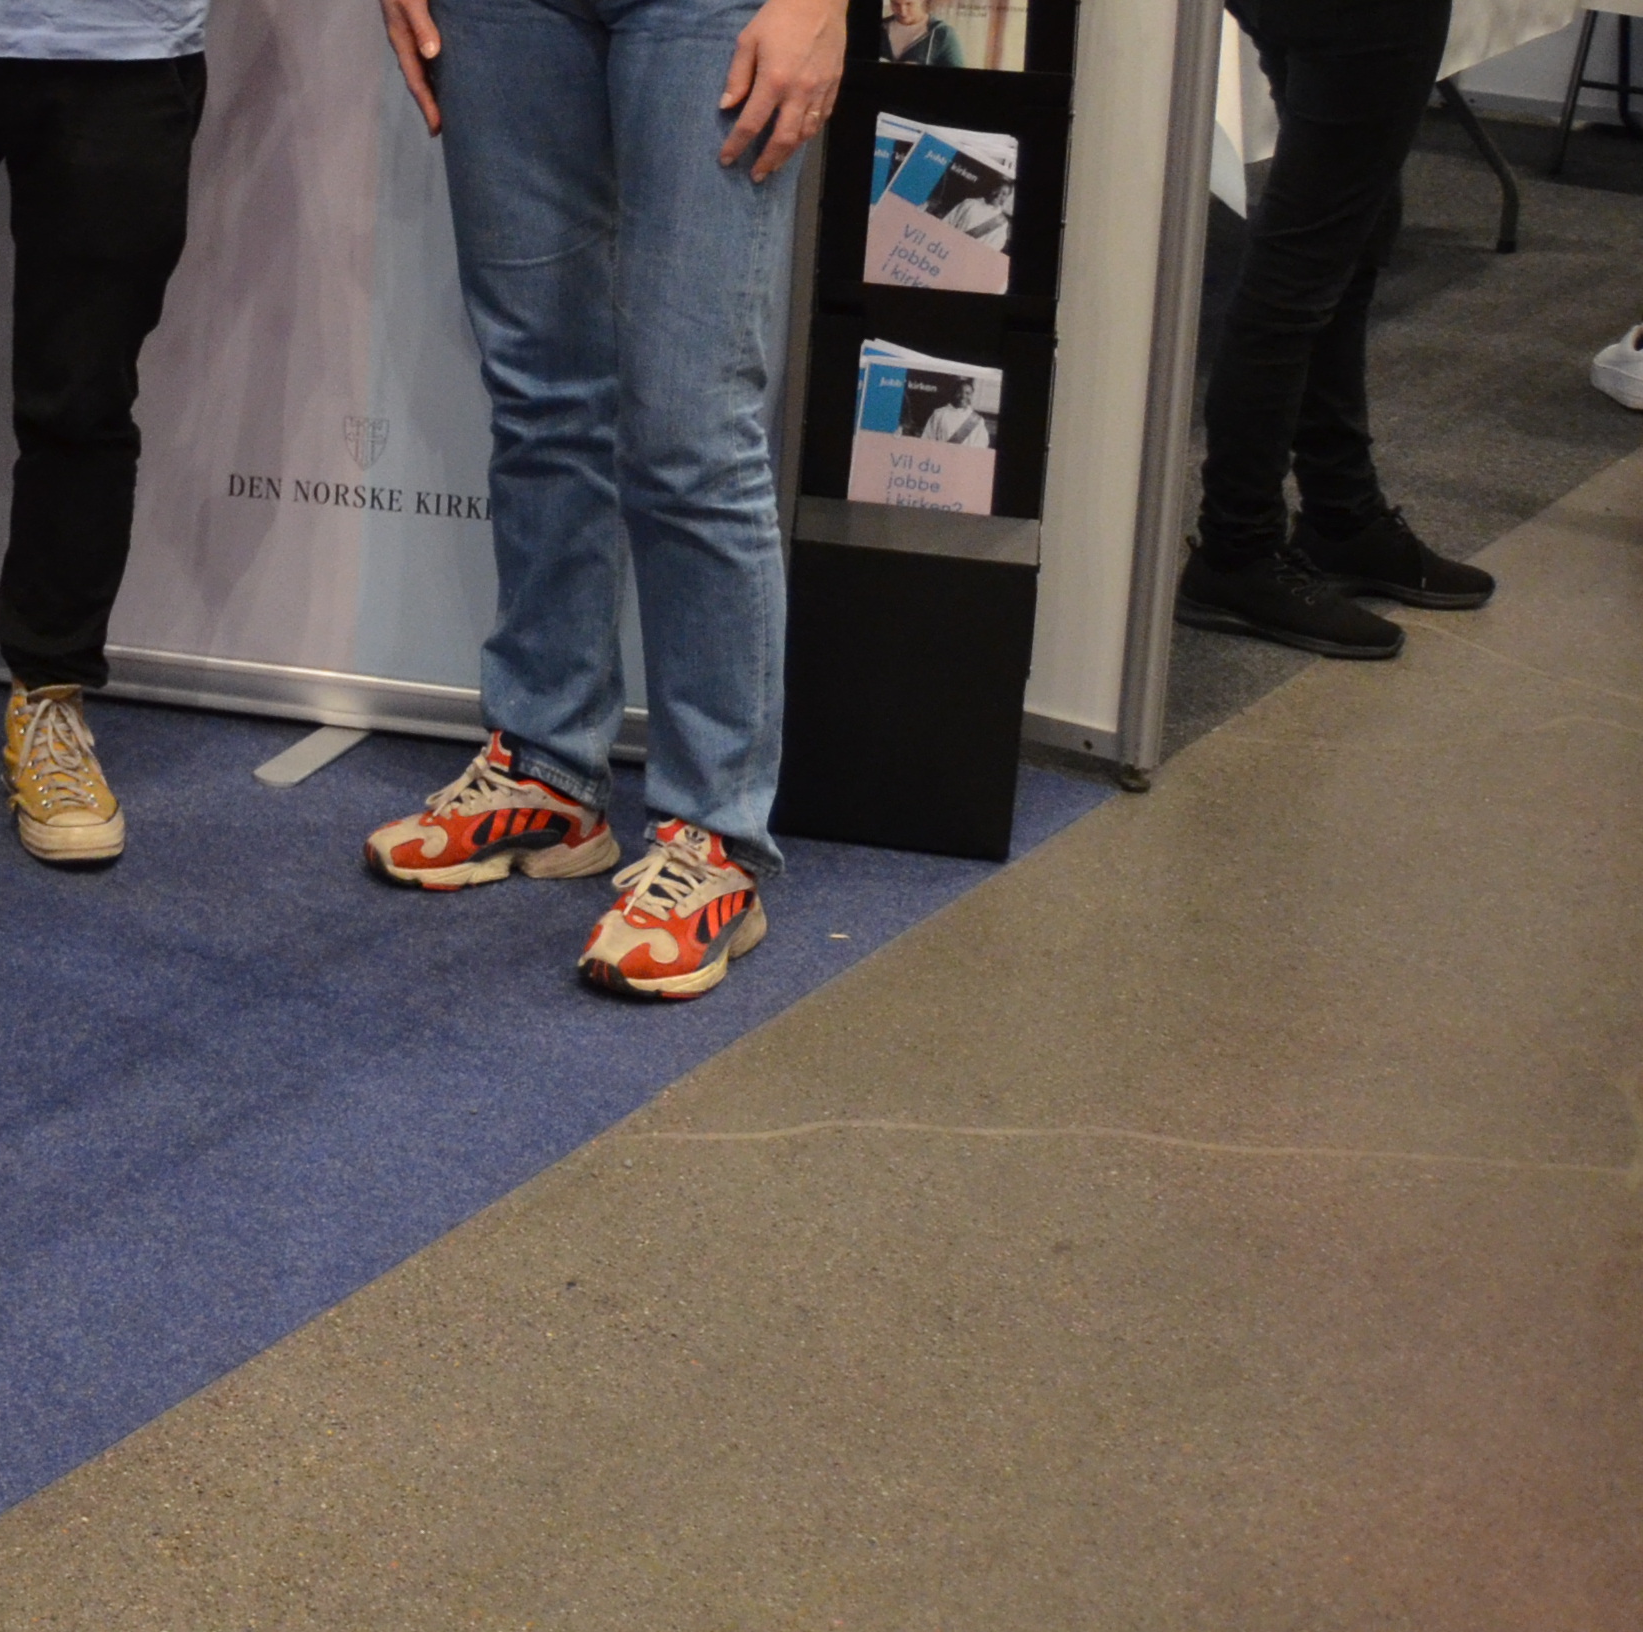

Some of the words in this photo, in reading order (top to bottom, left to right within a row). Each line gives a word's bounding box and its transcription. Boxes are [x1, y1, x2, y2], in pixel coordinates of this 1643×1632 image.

[889, 241, 940, 277] jobbe
[904, 224, 926, 246] Vil
[927, 241, 950, 260] du
[890, 453, 913, 469] Vil
[919, 459, 941, 474] du
[228, 474, 281, 500] DEN
[294, 480, 403, 513] NORSKE
[887, 472, 941, 493] jobbe
